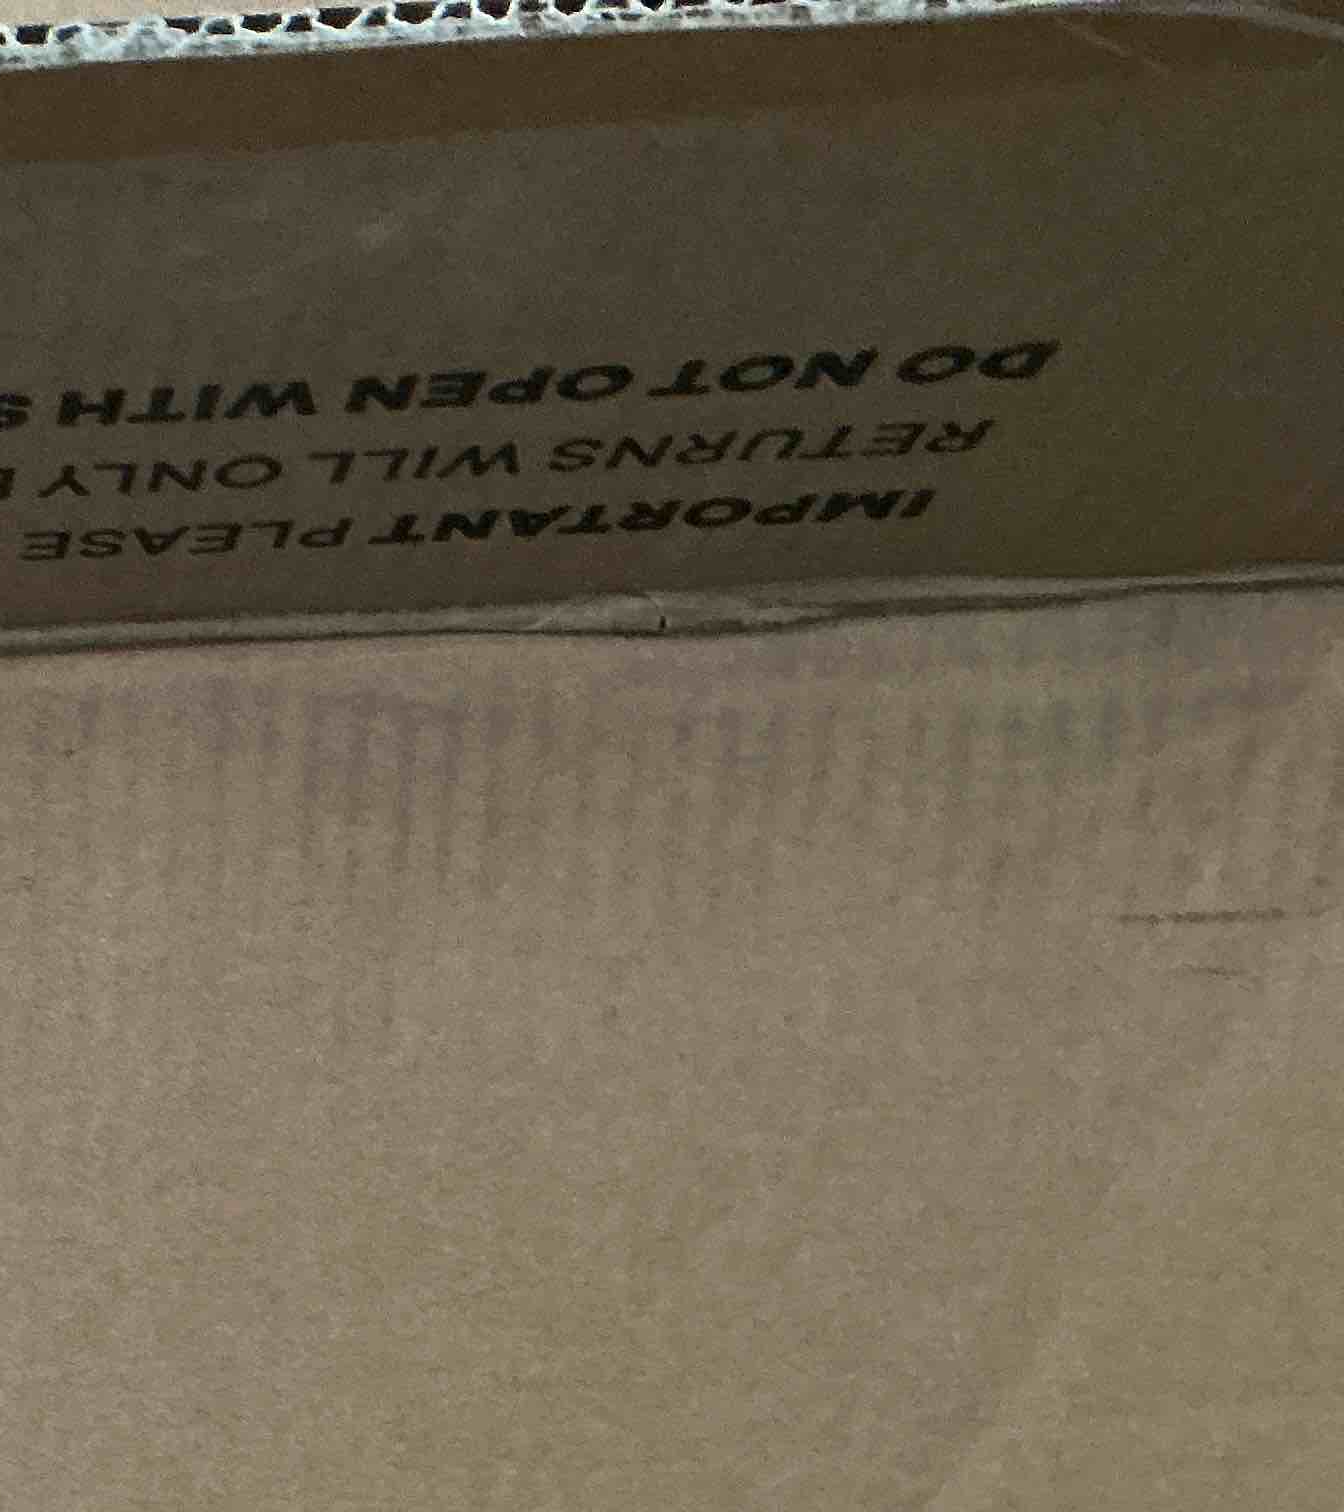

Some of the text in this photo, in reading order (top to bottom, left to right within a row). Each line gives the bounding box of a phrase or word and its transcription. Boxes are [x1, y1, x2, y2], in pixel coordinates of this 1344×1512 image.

[647, 347, 877, 397] NOT
[895, 339, 1057, 385] DO
[57, 381, 314, 426] WITH
[344, 364, 633, 412] OPEN
[306, 440, 520, 482] WILL
[547, 417, 994, 472] RETURNS
[36, 453, 284, 498] ONLY
[22, 515, 356, 560] PLEASE
[367, 488, 934, 546] IMPORTANT
